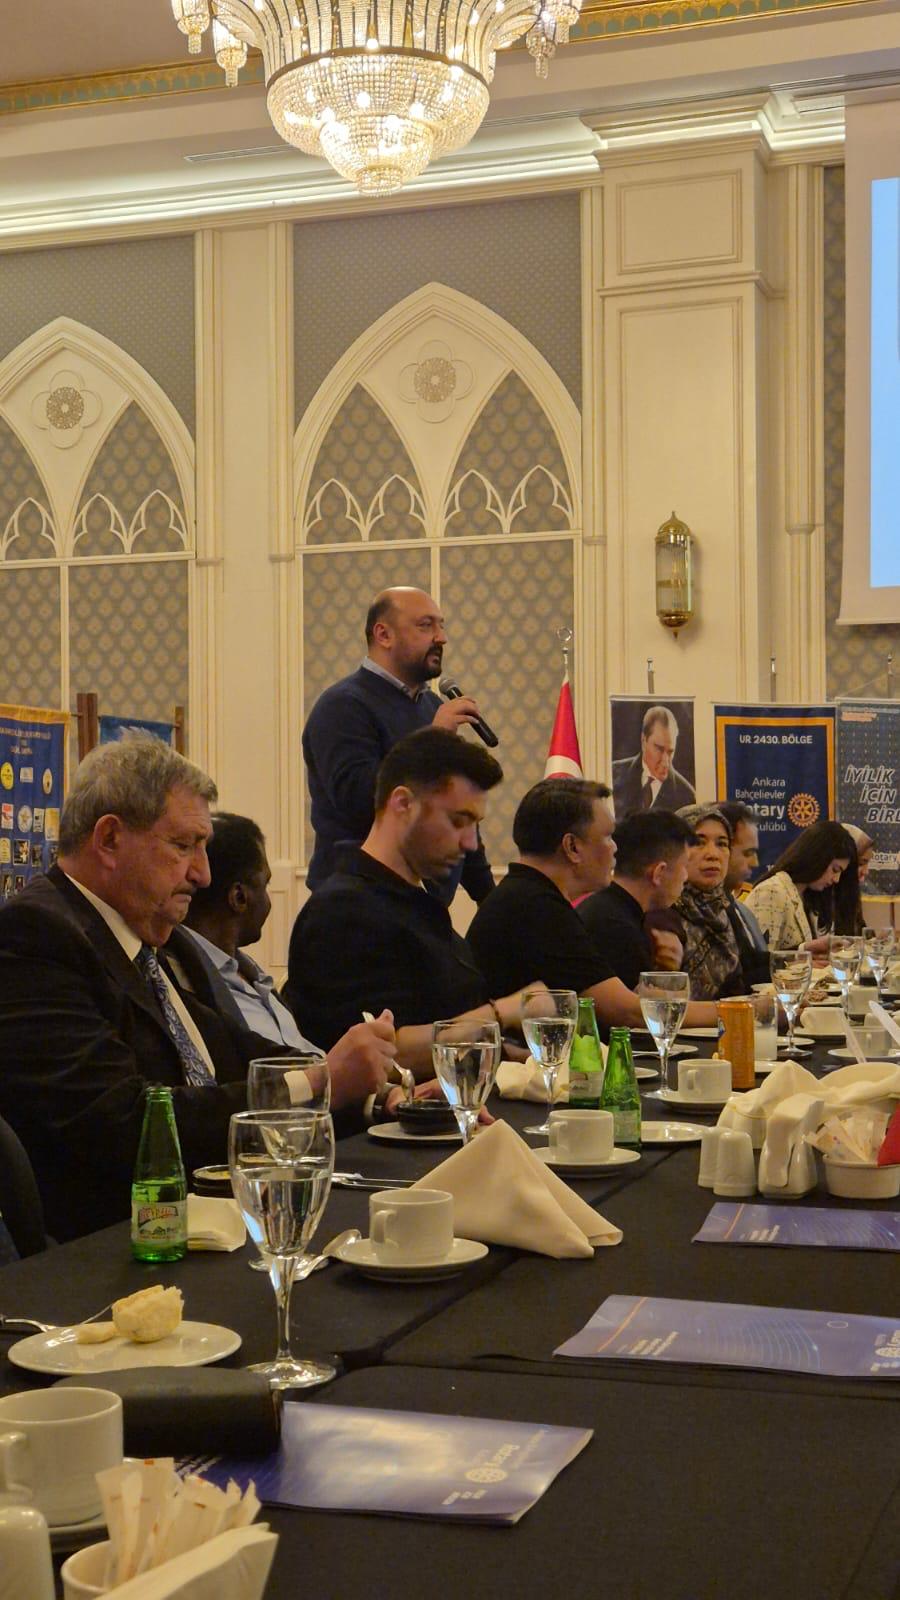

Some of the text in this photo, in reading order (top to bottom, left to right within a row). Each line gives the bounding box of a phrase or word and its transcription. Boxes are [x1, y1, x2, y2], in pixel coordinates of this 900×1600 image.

[739, 733, 813, 744] UR 2430. BÖLGE
[844, 763, 895, 784] İYİLİK
[752, 776, 786, 787] Ankara
[735, 788, 786, 801] Bahçelievler
[860, 784, 897, 805] İÇİN
[745, 802, 785, 820] otary
